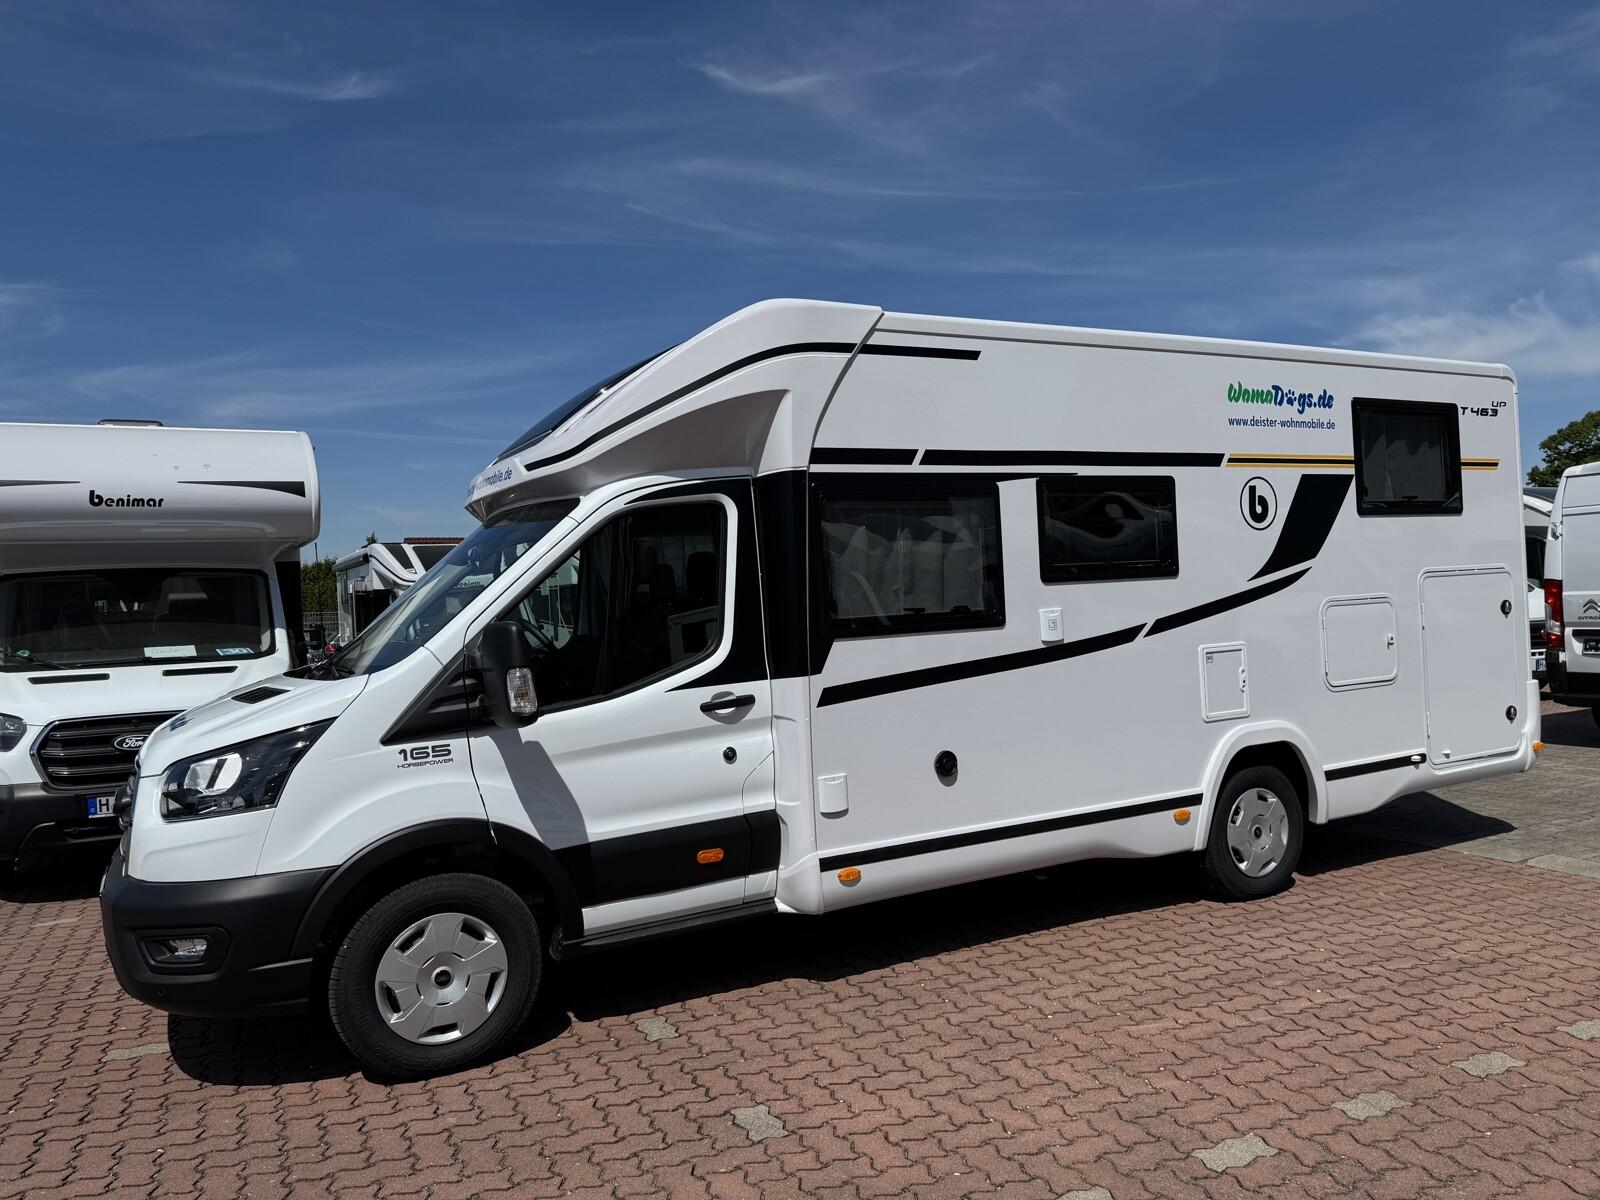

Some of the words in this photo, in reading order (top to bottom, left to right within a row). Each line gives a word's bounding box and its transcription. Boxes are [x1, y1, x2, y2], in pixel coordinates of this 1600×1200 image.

[1460, 406, 1469, 416] T
[1470, 407, 1499, 417] 463
[1491, 400, 1507, 408] UP
[1228, 416, 1336, 429] www.deister-wohnmobile.de
[89, 489, 164, 507] benimar
[398, 743, 452, 761] 165
[397, 758, 454, 769] HORSEPOWER
